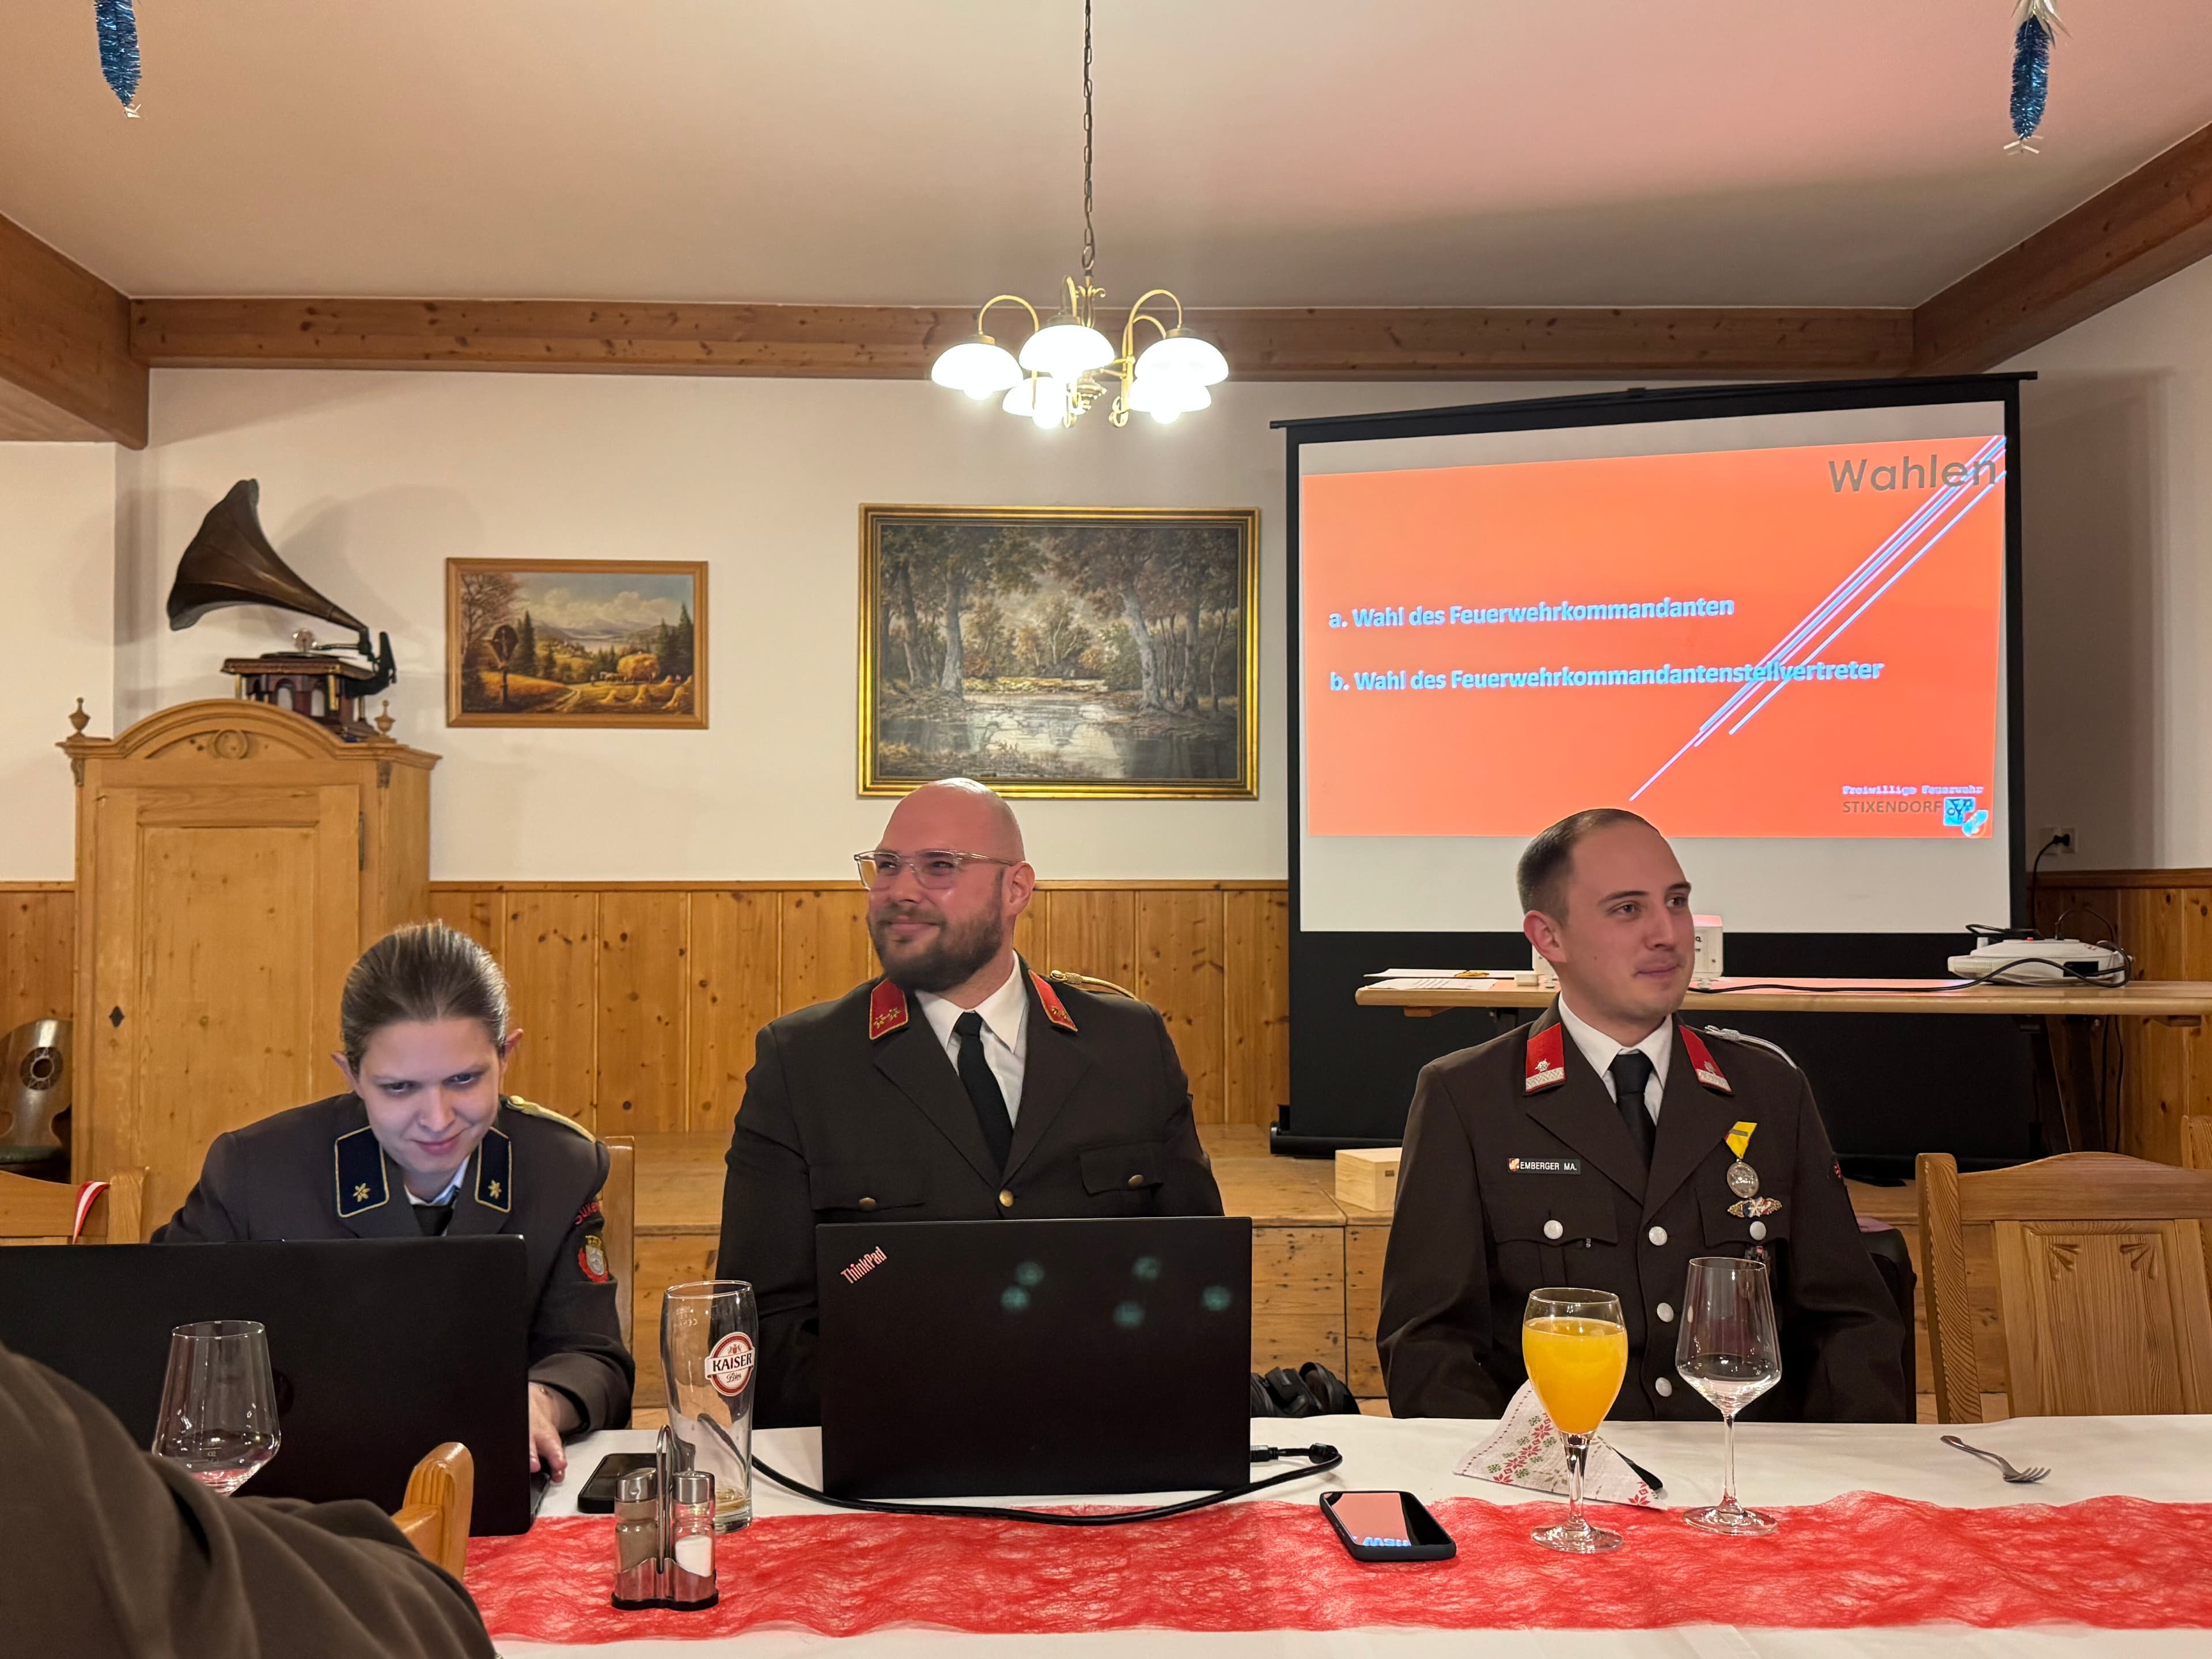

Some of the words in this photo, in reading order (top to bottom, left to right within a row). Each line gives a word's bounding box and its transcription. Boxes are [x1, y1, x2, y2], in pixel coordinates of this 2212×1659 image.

[1828, 454, 1997, 493] Wahlen
[1329, 613, 1348, 628] a.
[1351, 606, 1404, 627] Wahl
[1409, 605, 1445, 626] des
[1449, 597, 1734, 624] Feuerwehrkommandanten
[1330, 671, 1350, 691] b.
[1354, 670, 1406, 691] Wahl
[1410, 669, 1446, 690] des
[1451, 660, 1884, 688] Feuerwehrkommandantenstellvertreter
[1843, 800, 1942, 813] STIXENDORF
[1520, 1161, 1560, 1171] EMBERGER
[1564, 1162, 1577, 1171] MA.
[840, 1245, 887, 1284] ThinkPad
[713, 1353, 752, 1372] KAISER
